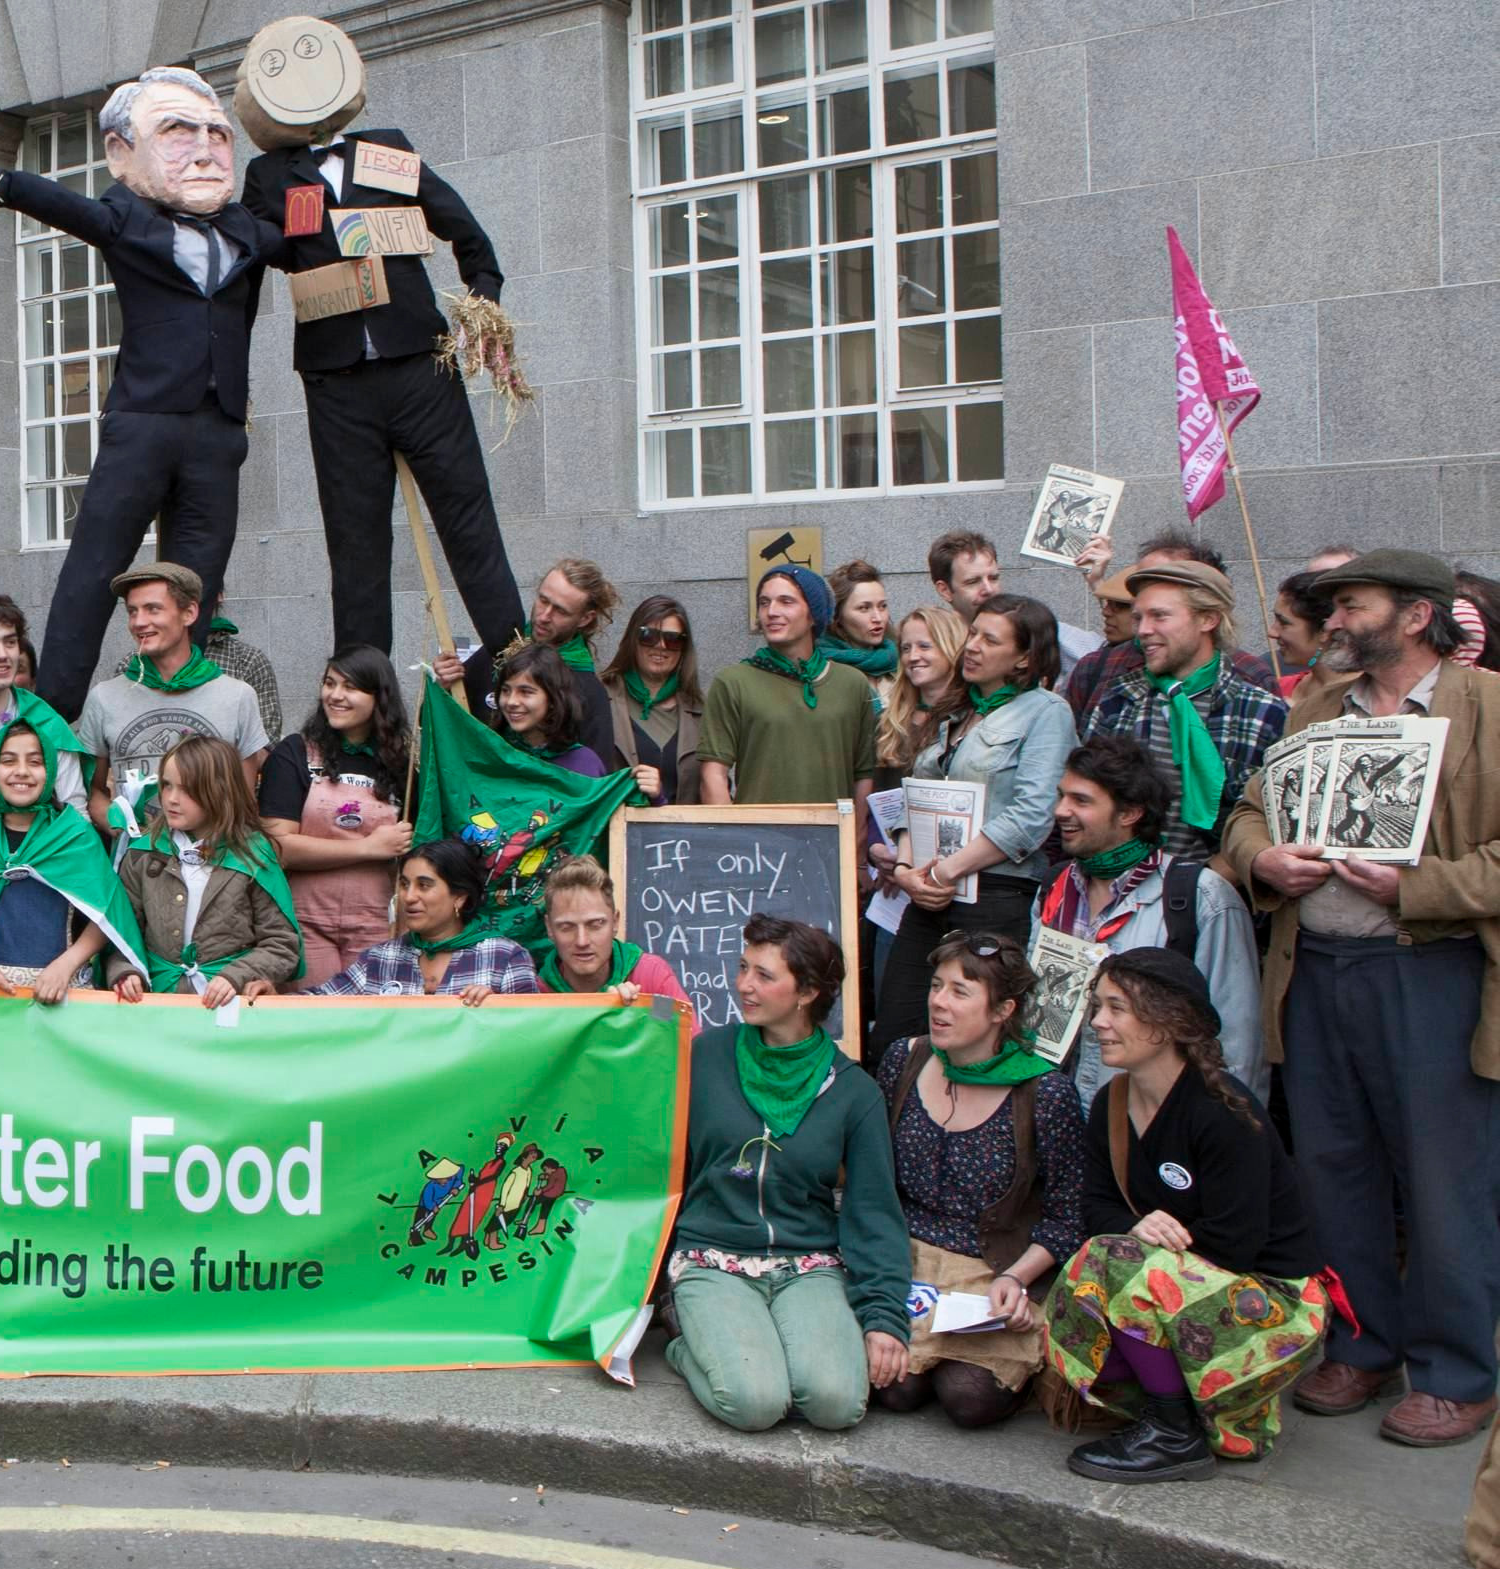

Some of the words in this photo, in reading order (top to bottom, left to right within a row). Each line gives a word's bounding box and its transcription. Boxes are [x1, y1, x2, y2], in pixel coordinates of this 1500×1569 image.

[359, 148, 419, 174] TESCO
[363, 209, 429, 253] NFU
[161, 715, 193, 726] WANDER
[1366, 719, 1397, 729] LAND
[346, 776, 373, 788] Work
[644, 839, 691, 873] If
[717, 842, 787, 899] only
[641, 886, 754, 917] OWEN
[680, 959, 729, 990] had
[129, 1116, 323, 1216] Food
[380, 1197, 595, 1288] CAMPESINA
[104, 1243, 175, 1293] the
[190, 1246, 324, 1293] future
